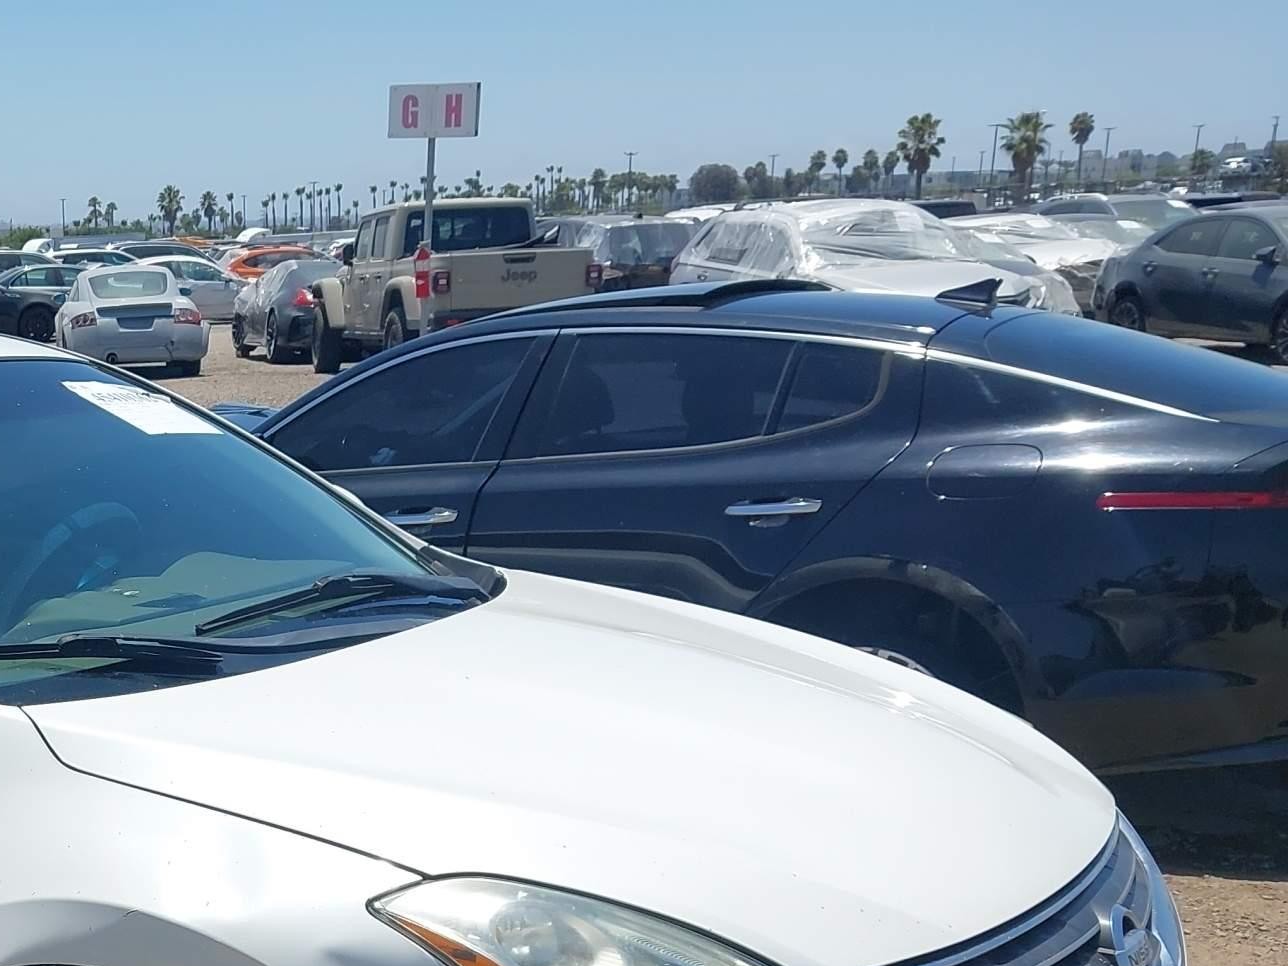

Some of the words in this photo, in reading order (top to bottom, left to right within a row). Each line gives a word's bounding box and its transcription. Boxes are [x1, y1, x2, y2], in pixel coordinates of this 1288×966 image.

[402, 94, 419, 128] G
[444, 94, 462, 128] H
[501, 269, 537, 283] Jeep
